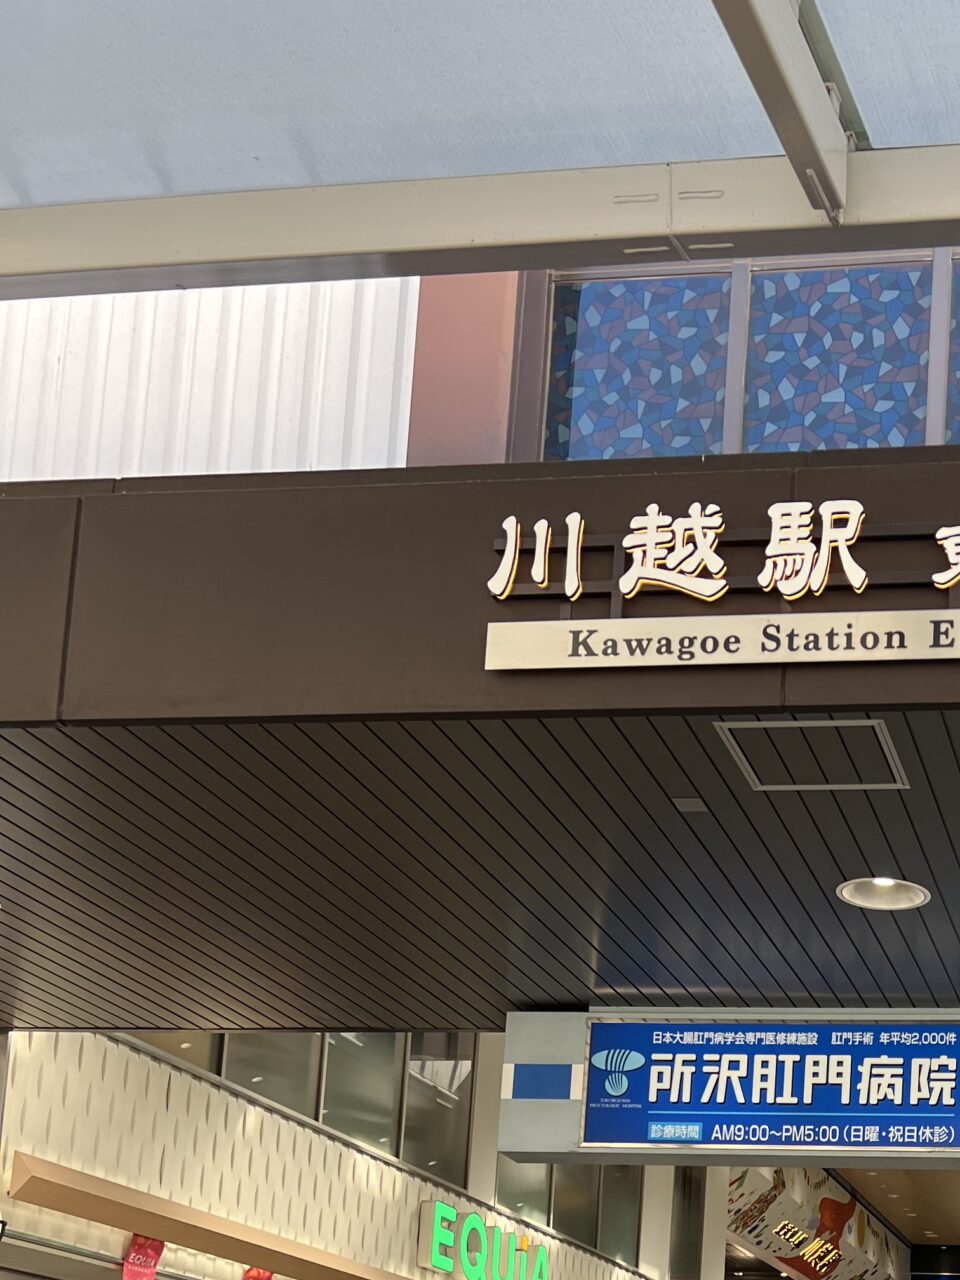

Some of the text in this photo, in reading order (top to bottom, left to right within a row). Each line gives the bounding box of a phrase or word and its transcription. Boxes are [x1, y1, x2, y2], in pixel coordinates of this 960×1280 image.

[487, 499, 869, 602] 川越駅
[567, 629, 742, 661] Kawagoe
[760, 623, 908, 653] Station
[831, 1032, 873, 1045] 肛門手術
[879, 1032, 957, 1046] 年平均2,000件
[648, 1053, 958, 1106] 所沢肛門病院
[651, 1124, 699, 1139] 診療時間
